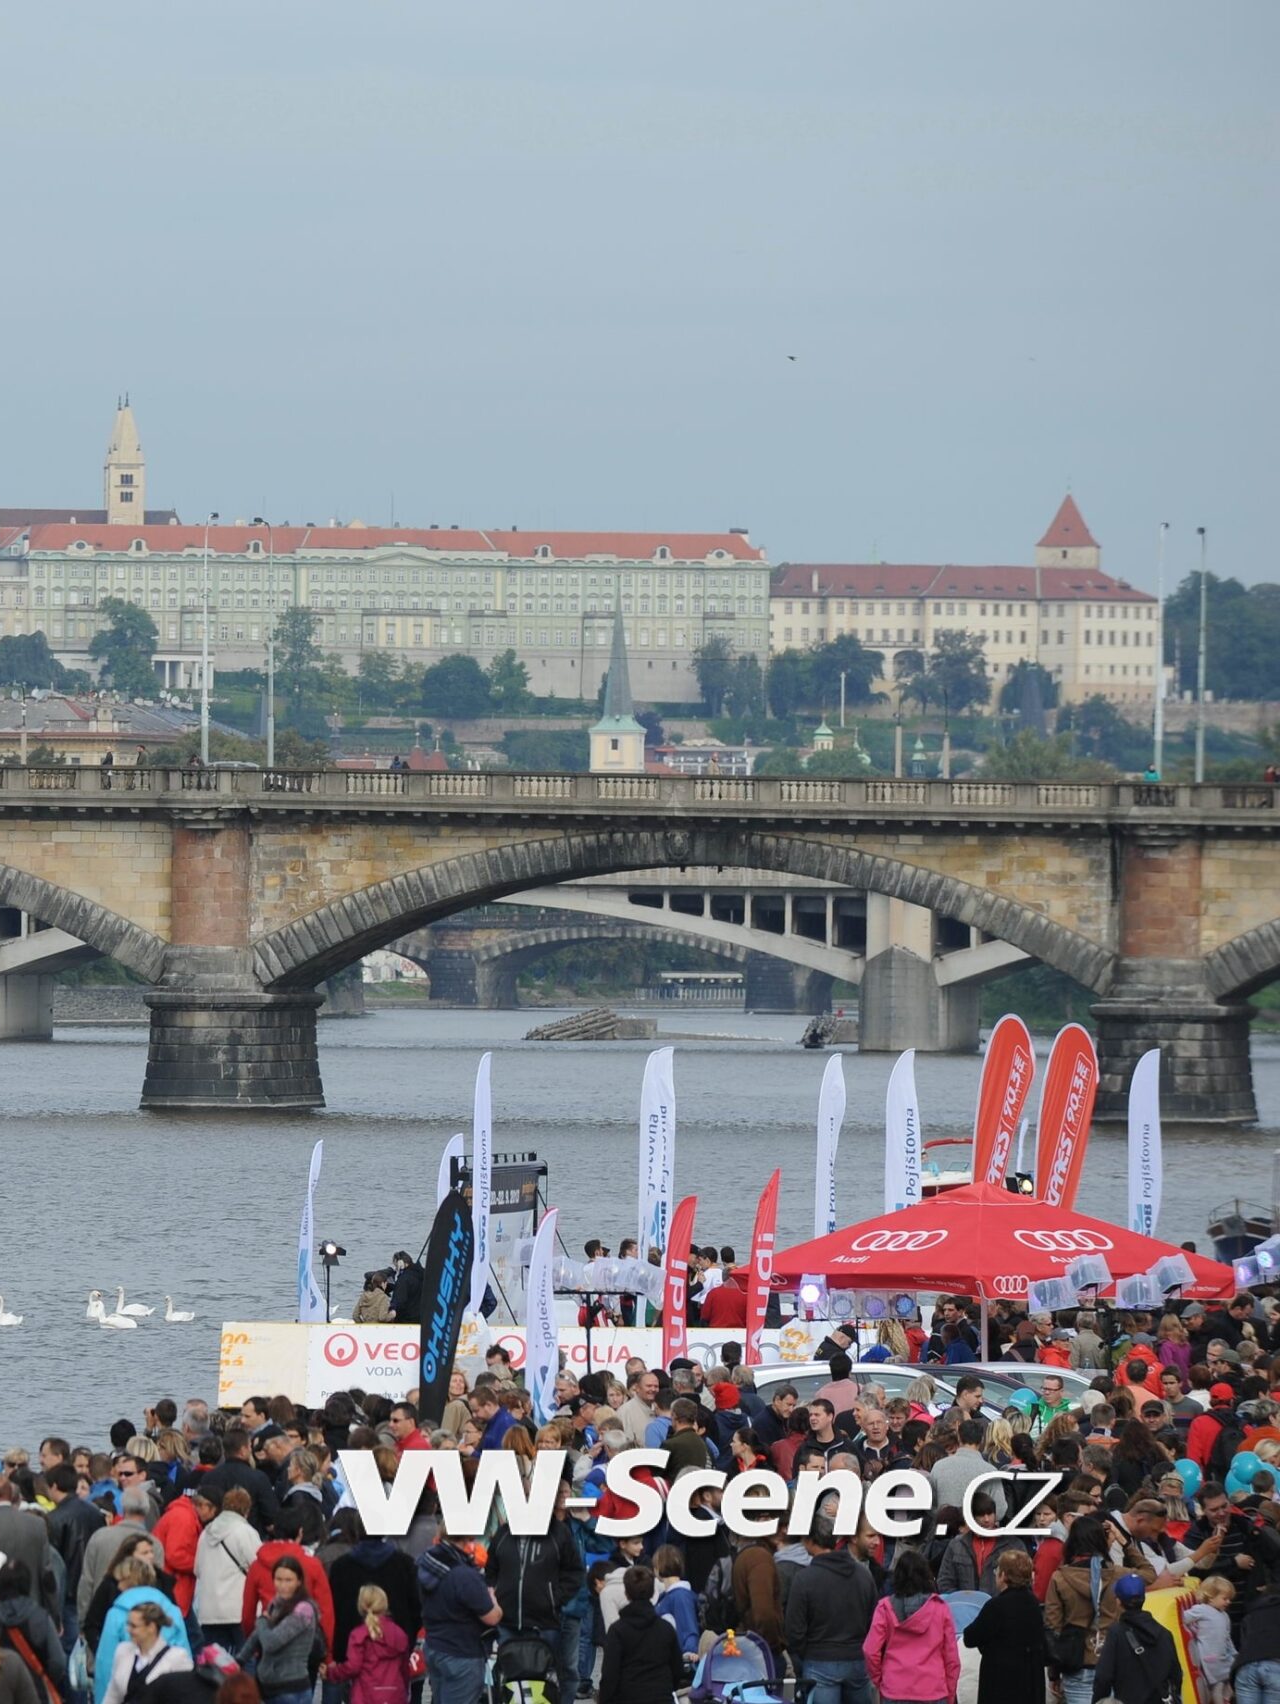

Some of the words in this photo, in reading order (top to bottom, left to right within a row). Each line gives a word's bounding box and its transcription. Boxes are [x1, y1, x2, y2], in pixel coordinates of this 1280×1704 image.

[829, 1255, 871, 1263] Audi
[1049, 1255, 1079, 1263] Aud
[364, 1342, 420, 1360] VEO
[558, 1344, 633, 1364] OLIA
[366, 1366, 403, 1377] VODA
